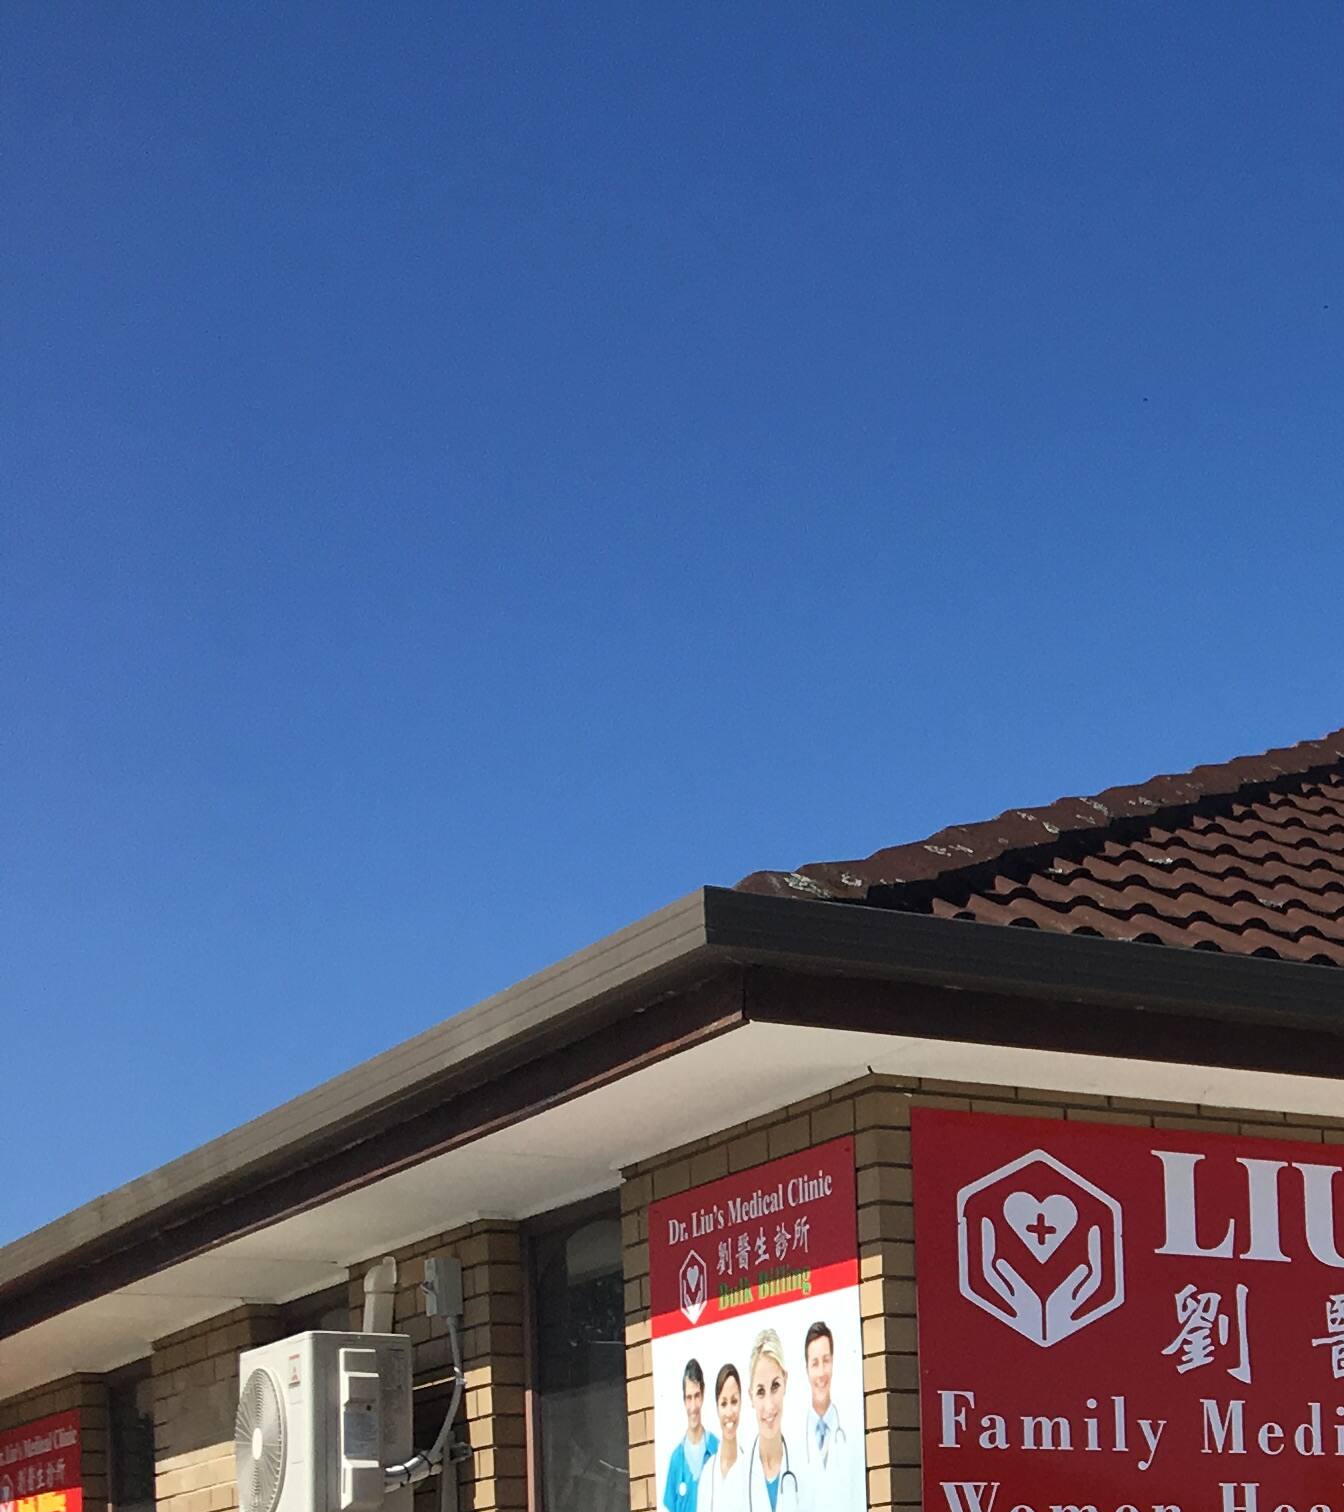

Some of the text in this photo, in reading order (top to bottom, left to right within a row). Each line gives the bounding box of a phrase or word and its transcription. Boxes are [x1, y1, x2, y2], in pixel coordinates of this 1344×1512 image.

[668, 1169, 833, 1245] Dr. Liu's Medical Clinic
[937, 1390, 1168, 1471] Family
